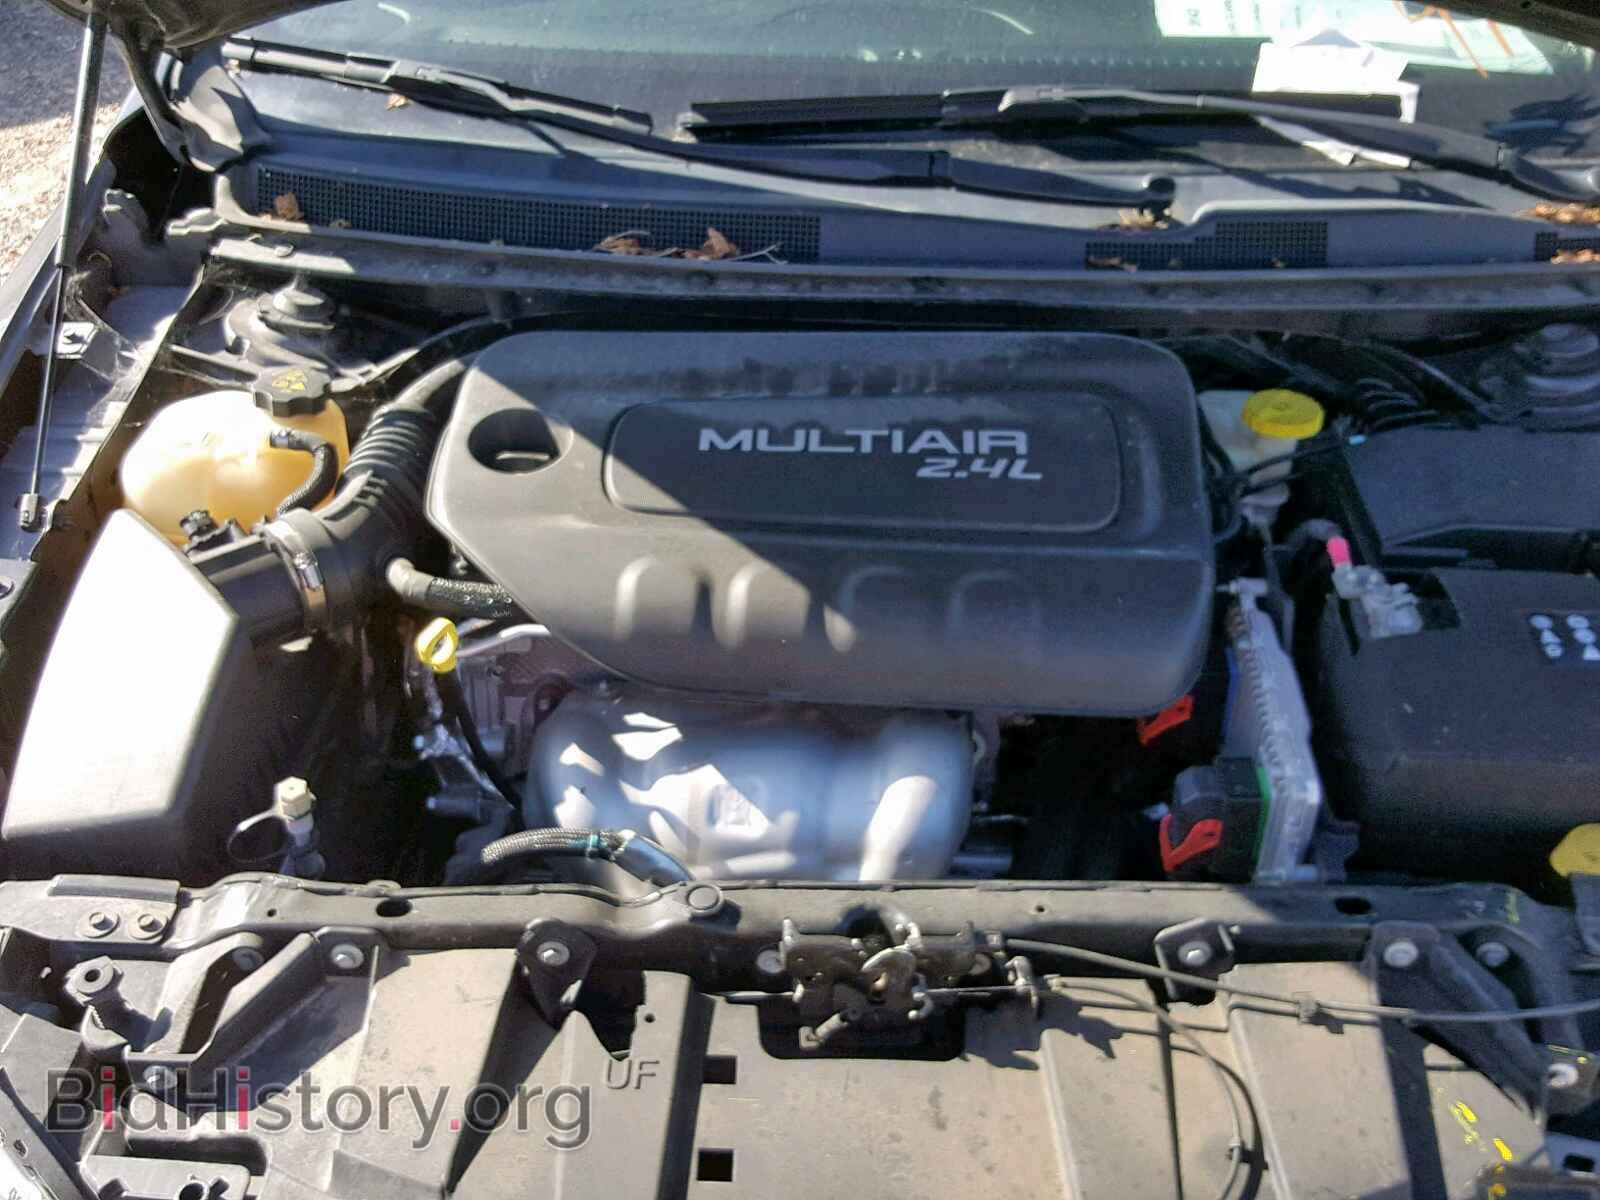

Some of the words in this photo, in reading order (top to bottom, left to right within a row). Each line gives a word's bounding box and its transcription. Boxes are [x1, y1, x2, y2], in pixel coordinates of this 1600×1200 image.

[698, 428, 1028, 455] MULTIAIR
[915, 457, 1043, 480] 2.4L
[605, 1058, 660, 1090] UF
